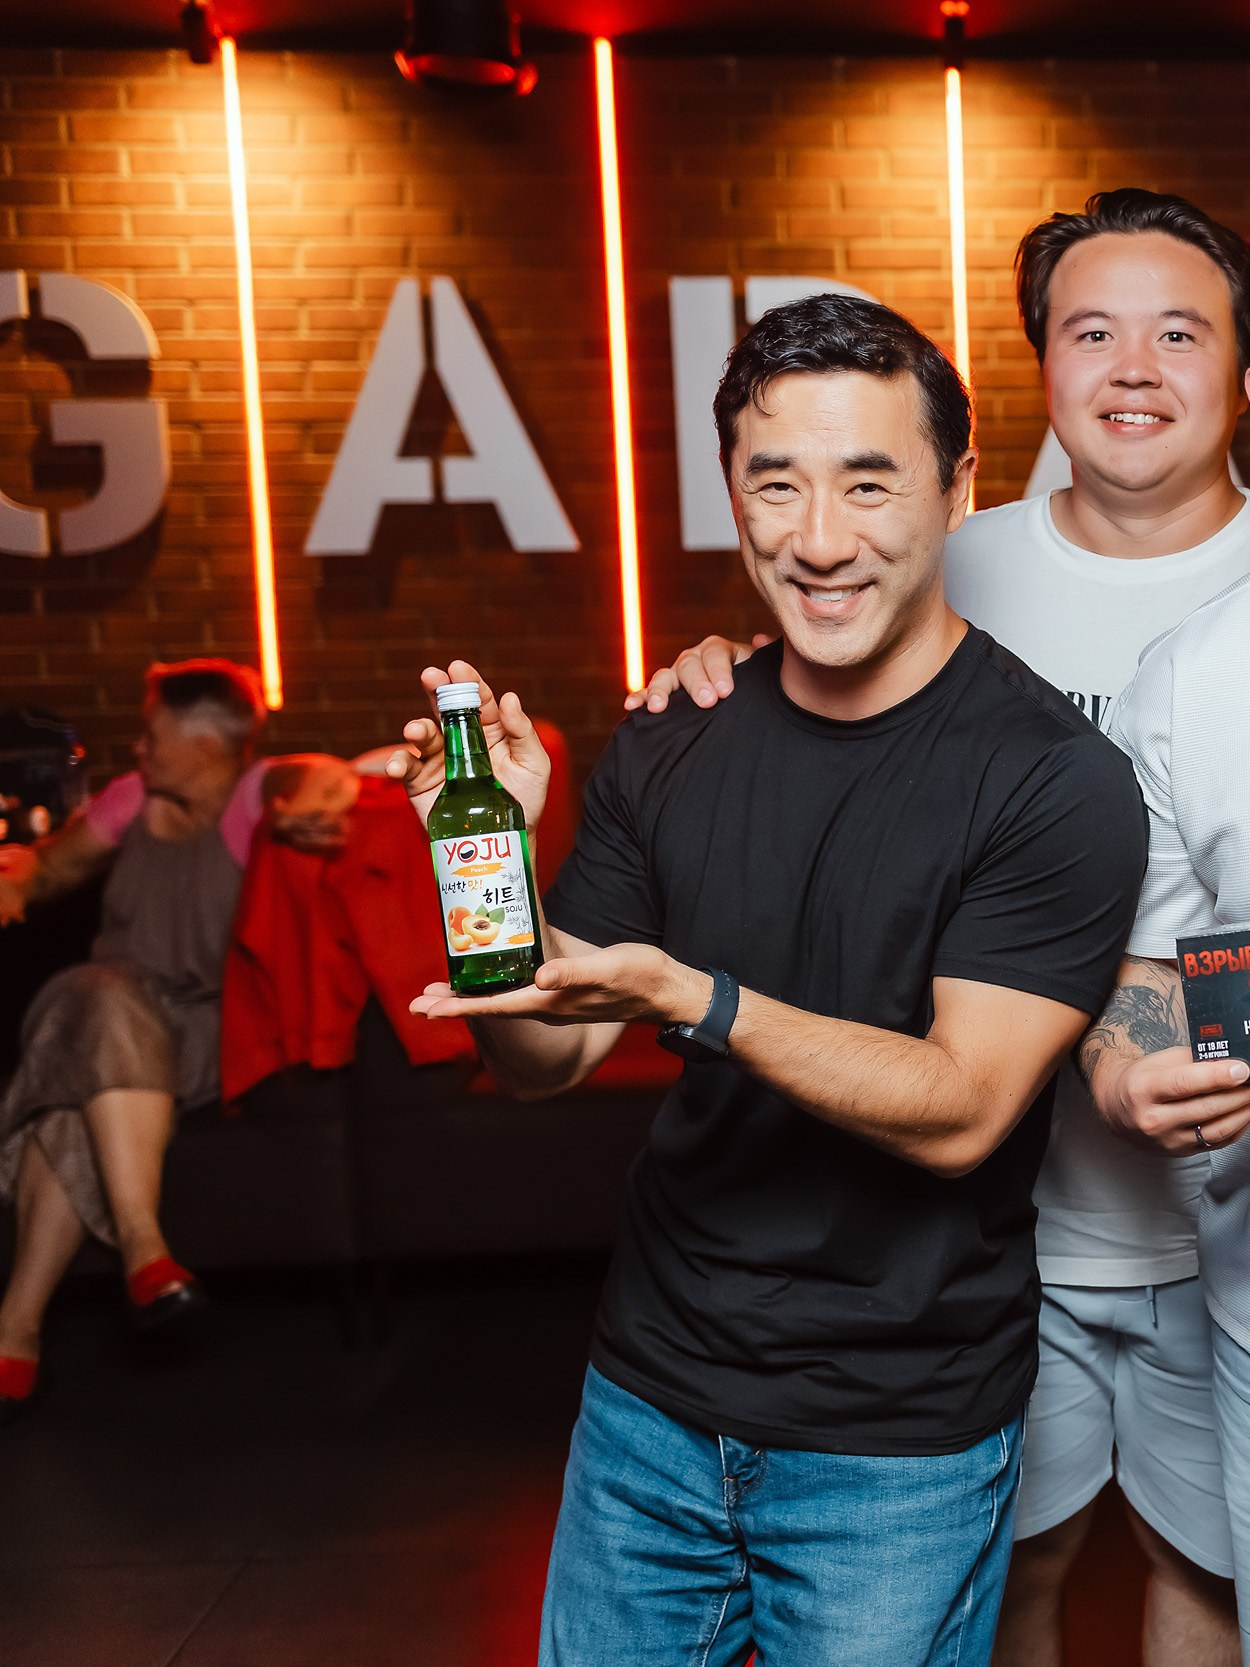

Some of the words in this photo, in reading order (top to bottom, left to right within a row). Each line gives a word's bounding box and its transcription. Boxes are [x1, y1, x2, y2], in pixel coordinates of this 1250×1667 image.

[443, 835, 511, 865] YOJU
[482, 886, 515, 905] 히트
[505, 904, 523, 913] SOJU
[1197, 1043, 1206, 1052] ОТ
[1207, 1042, 1215, 1051] 18
[1216, 1041, 1228, 1050] ЛЕТ
